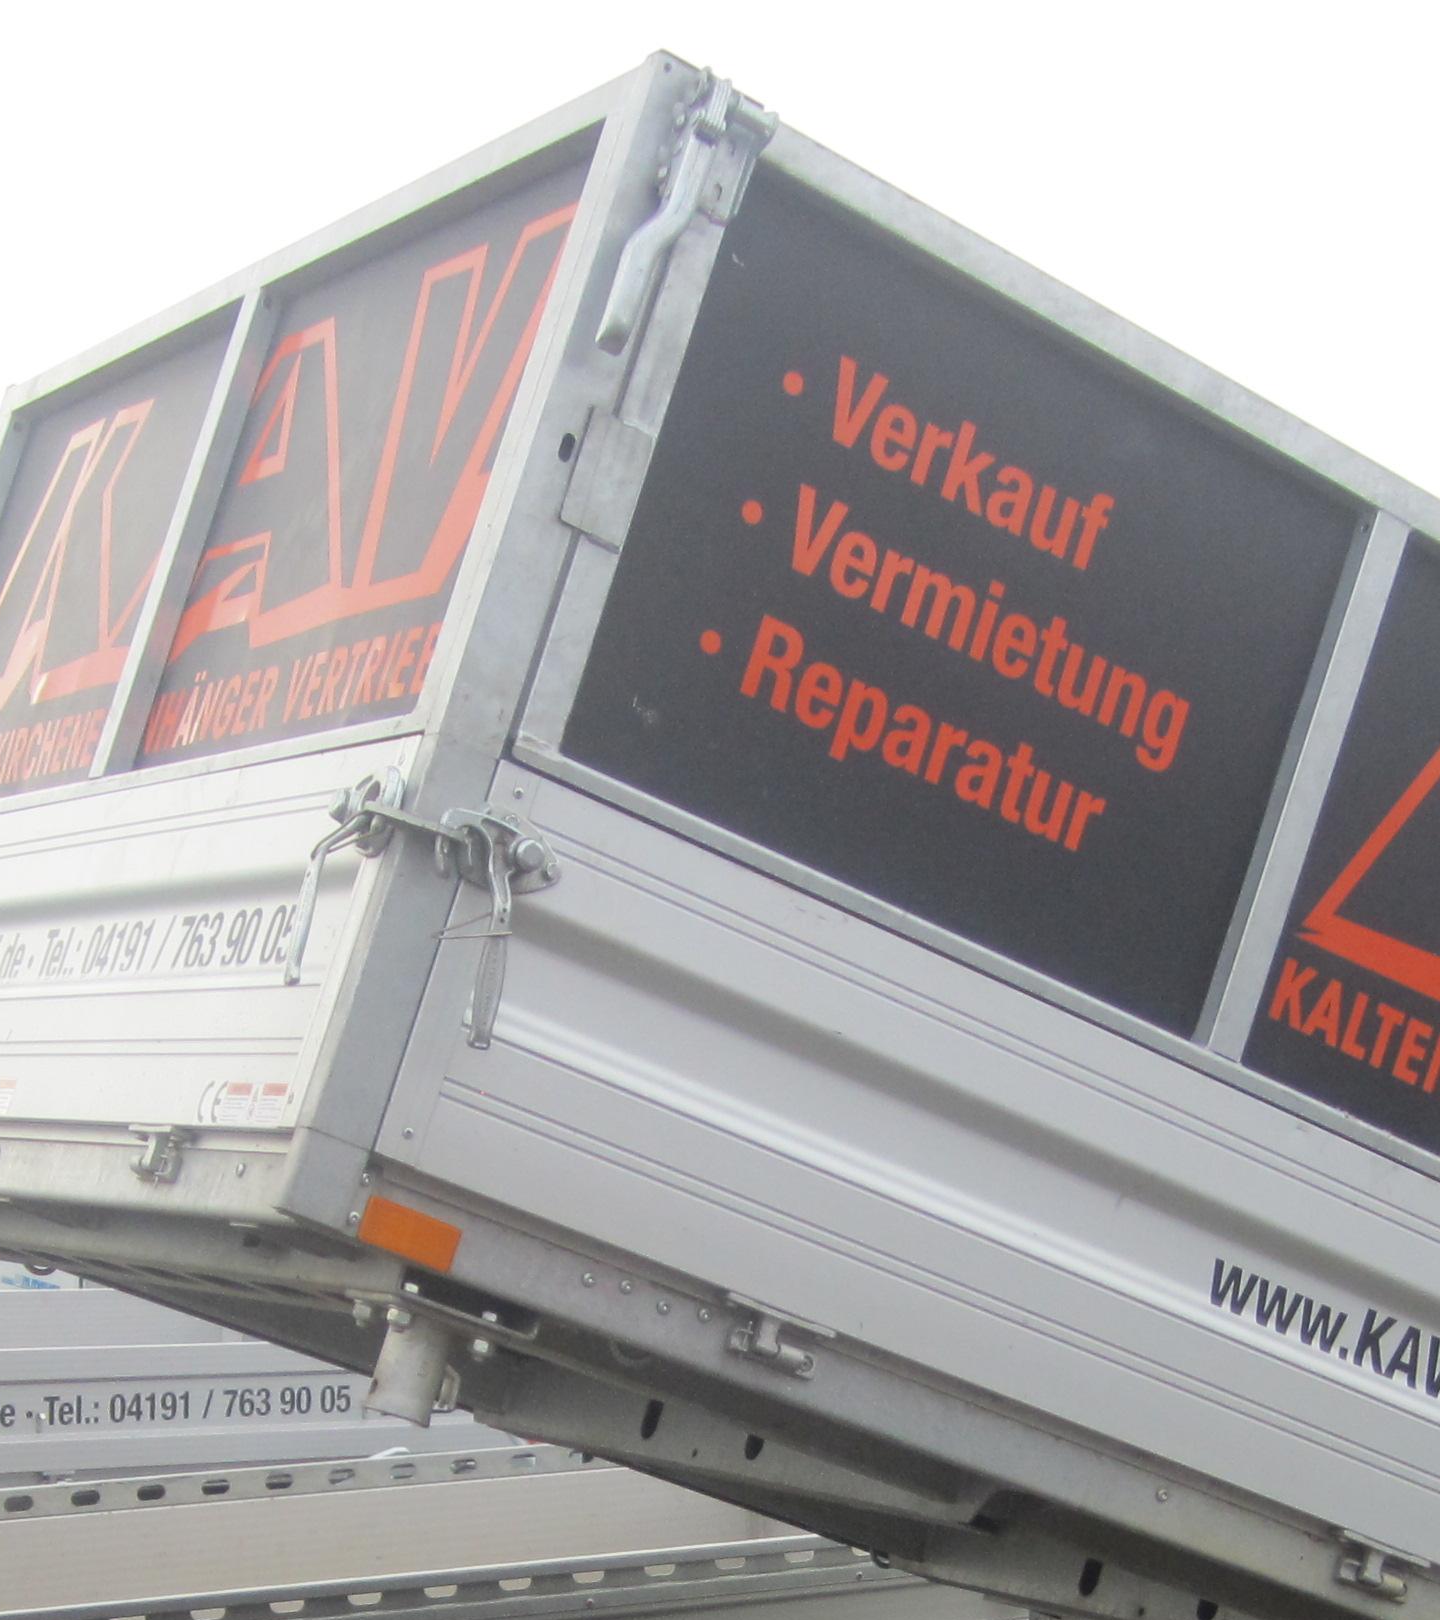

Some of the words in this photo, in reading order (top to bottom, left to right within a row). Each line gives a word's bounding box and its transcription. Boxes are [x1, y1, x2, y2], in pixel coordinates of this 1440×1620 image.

[833, 355, 1114, 571] Verkauf
[740, 614, 1107, 851] Reparatur
[791, 483, 1190, 771] Vermietung
[38, 926, 83, 977] Tel.:
[81, 919, 156, 975] 04191
[171, 911, 225, 969] 763
[220, 908, 263, 967] 90
[43, 1396, 101, 1427] Tel.:
[108, 1389, 192, 1424] 04191
[201, 1387, 216, 1420] /
[223, 1386, 272, 1418] 763
[278, 1385, 314, 1416] 90
[318, 1384, 353, 1414] 05
